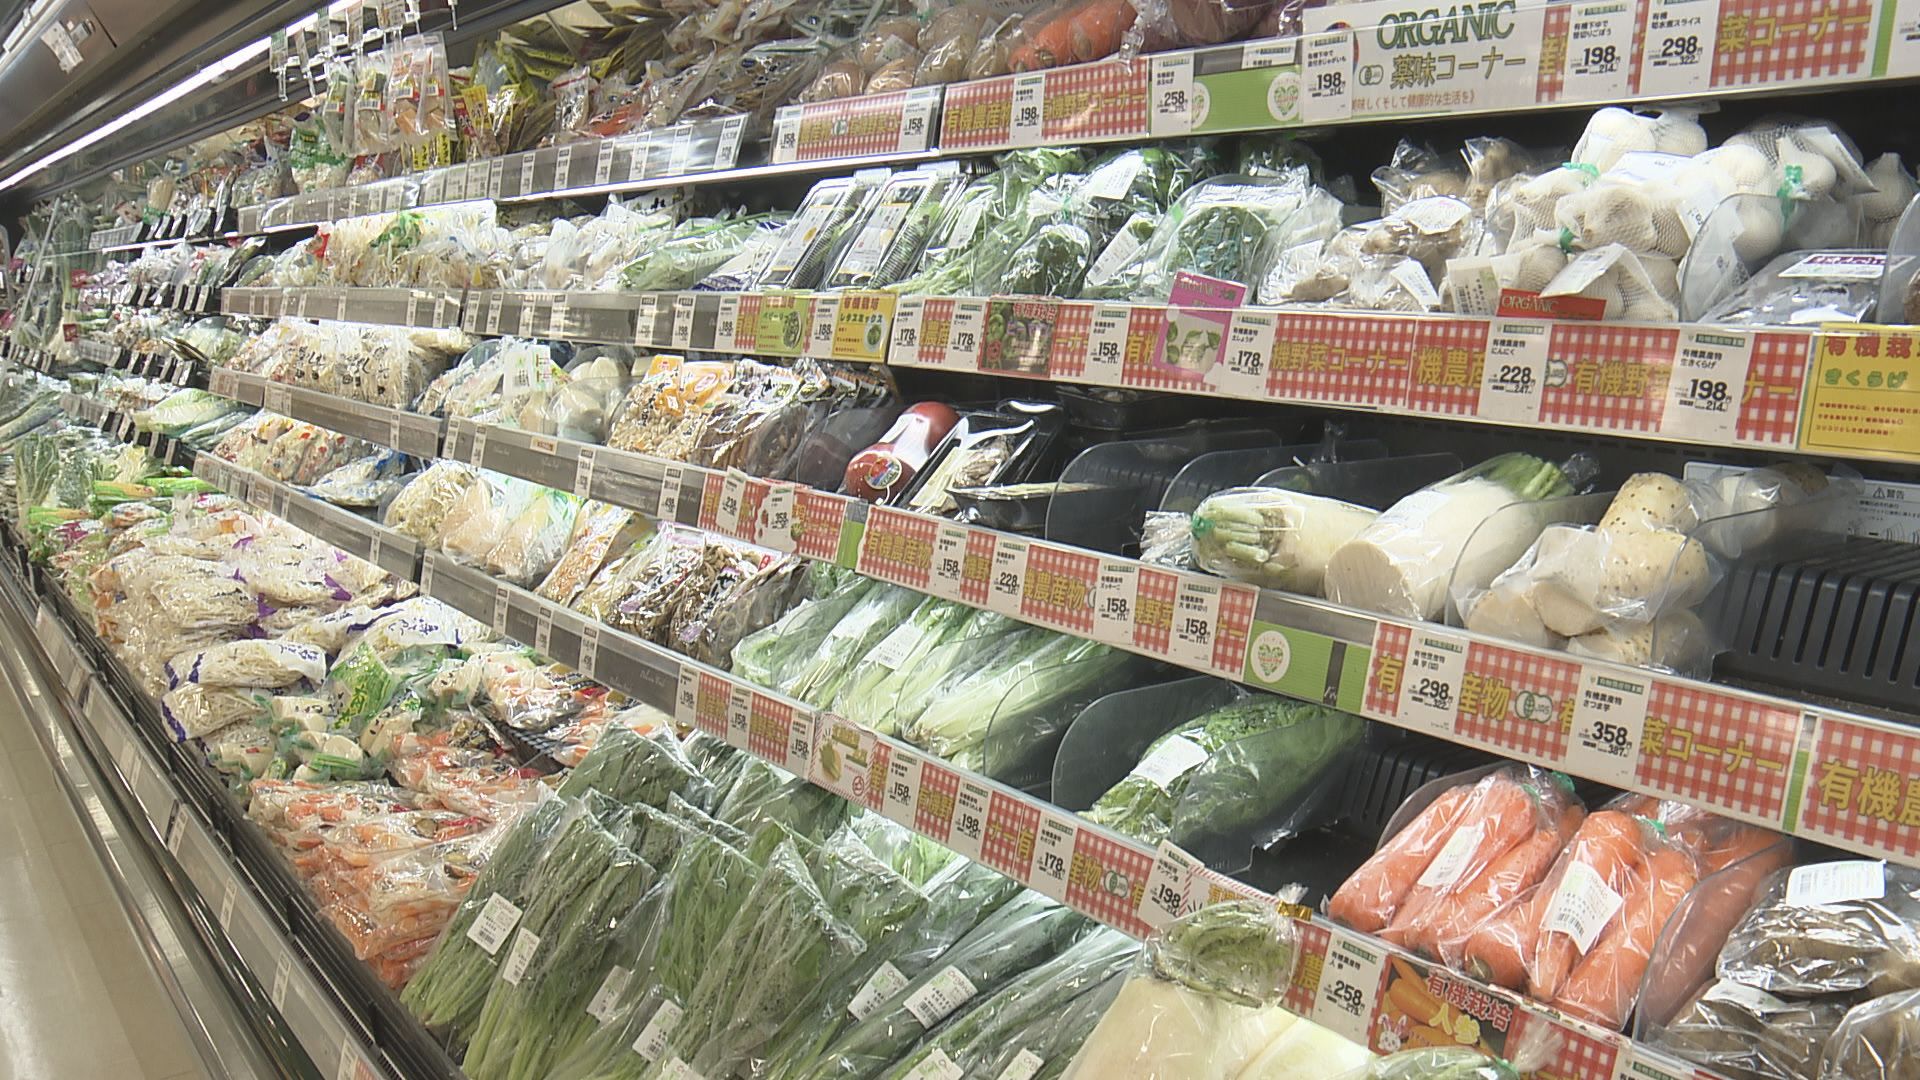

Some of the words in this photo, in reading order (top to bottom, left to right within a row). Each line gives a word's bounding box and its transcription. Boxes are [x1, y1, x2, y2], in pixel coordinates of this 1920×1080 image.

[1377, 1, 1516, 49] ORGANIC
[1390, 46, 1526, 90] 薬味コーナー
[1164, 90, 1186, 107] 258
[1020, 106, 1037, 121] 198
[1012, 302, 1058, 321] 有機栽培
[900, 328, 915, 345] 178
[958, 332, 974, 346] 178
[1098, 342, 1119, 358] 158
[1491, 347, 1516, 357] にんにく
[1238, 350, 1261, 369] 178
[1679, 357, 1717, 371] 生きくらげ
[1705, 400, 1724, 412] 214
[942, 557, 960, 573] 158
[999, 571, 1019, 588] 228
[1106, 597, 1128, 613] 158
[1184, 616, 1208, 636] 158
[1377, 653, 1404, 695] 有
[1607, 743, 1626, 758] 387
[1641, 716, 1784, 774] 菜コーナー
[893, 781, 910, 797] 158
[962, 813, 980, 831] 198
[1044, 852, 1064, 872] 178
[1159, 883, 1181, 910] 198
[1425, 971, 1514, 1033] 有機栽培
